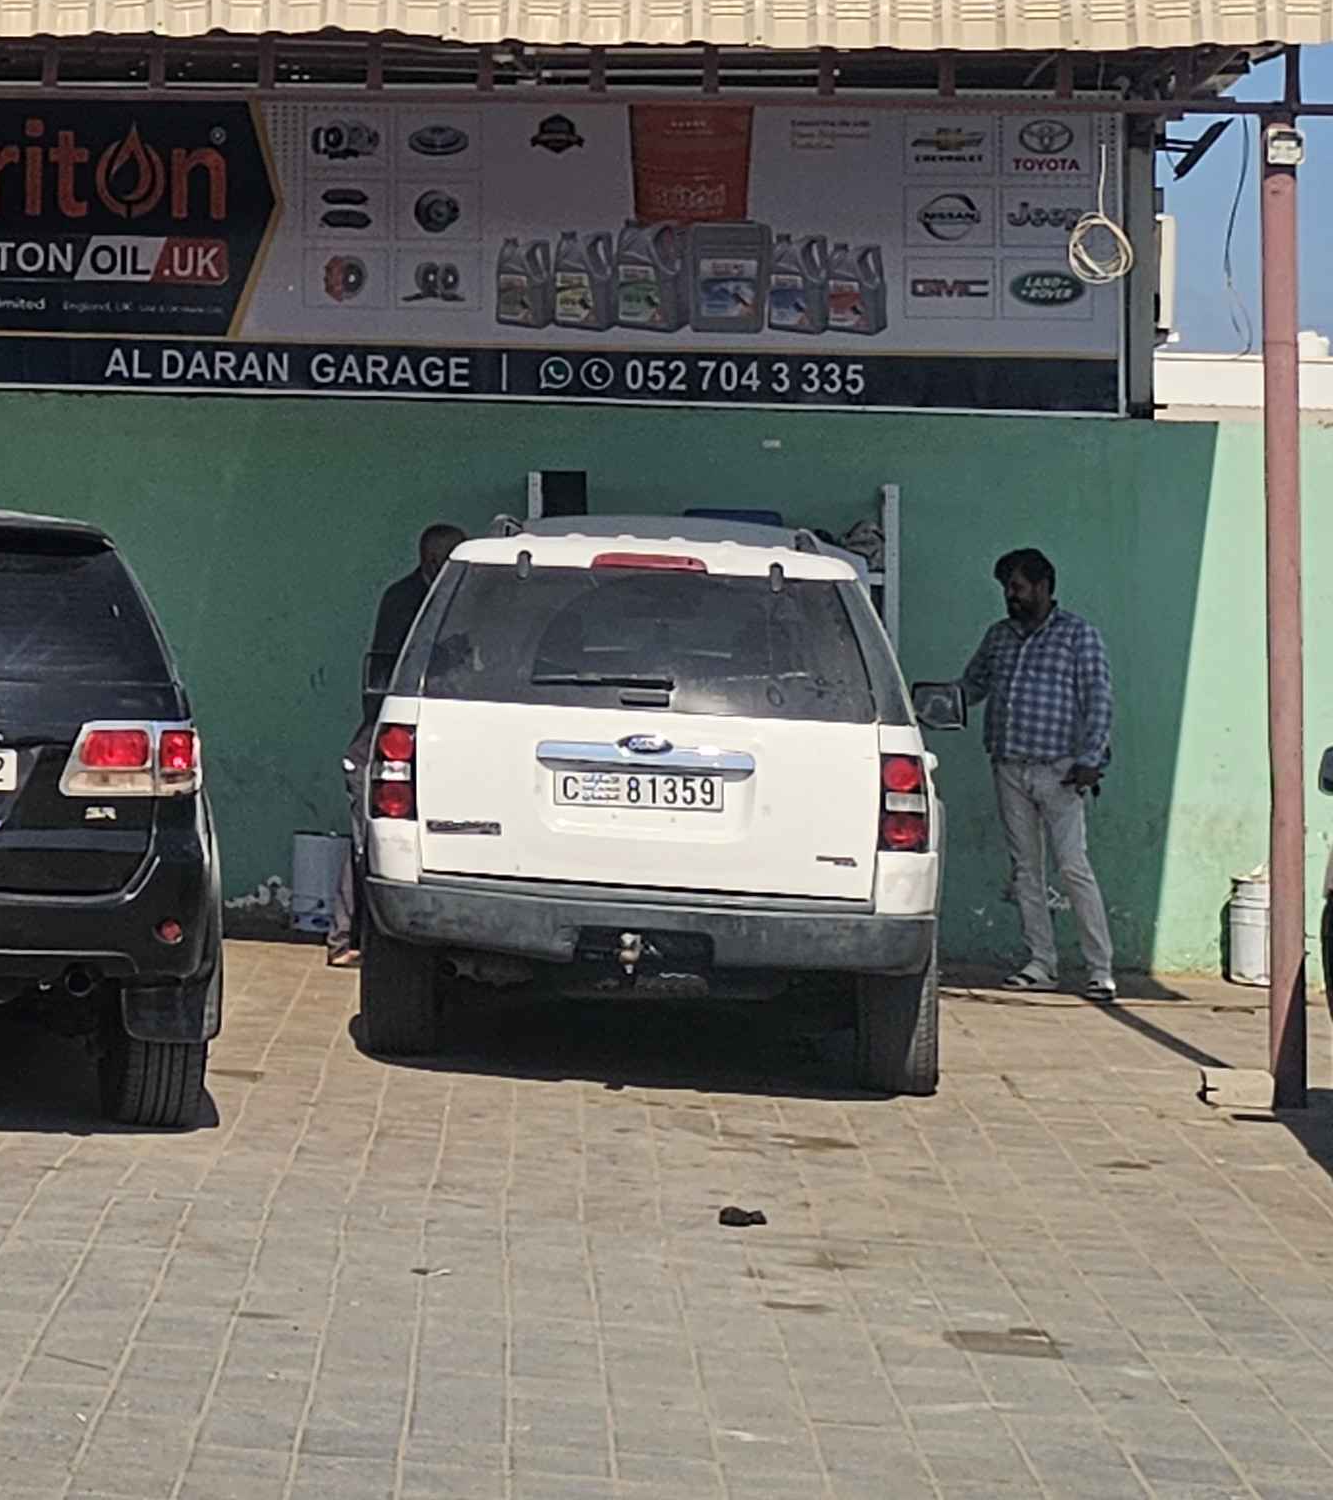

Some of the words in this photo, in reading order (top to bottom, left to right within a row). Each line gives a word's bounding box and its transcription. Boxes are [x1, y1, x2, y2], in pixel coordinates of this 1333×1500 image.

[1013, 158, 1080, 172] TOYOTA
[923, 211, 976, 221] NISSAN
[911, 279, 990, 298] GMC
[104, 348, 152, 380] AL
[160, 349, 290, 383] DARAN
[309, 353, 472, 388] GARAGE
[625, 360, 686, 391] 052
[699, 361, 761, 393] 704
[772, 363, 792, 393] 3
[801, 363, 866, 395] 335
[562, 775, 580, 800] C
[627, 777, 716, 805] 81359
